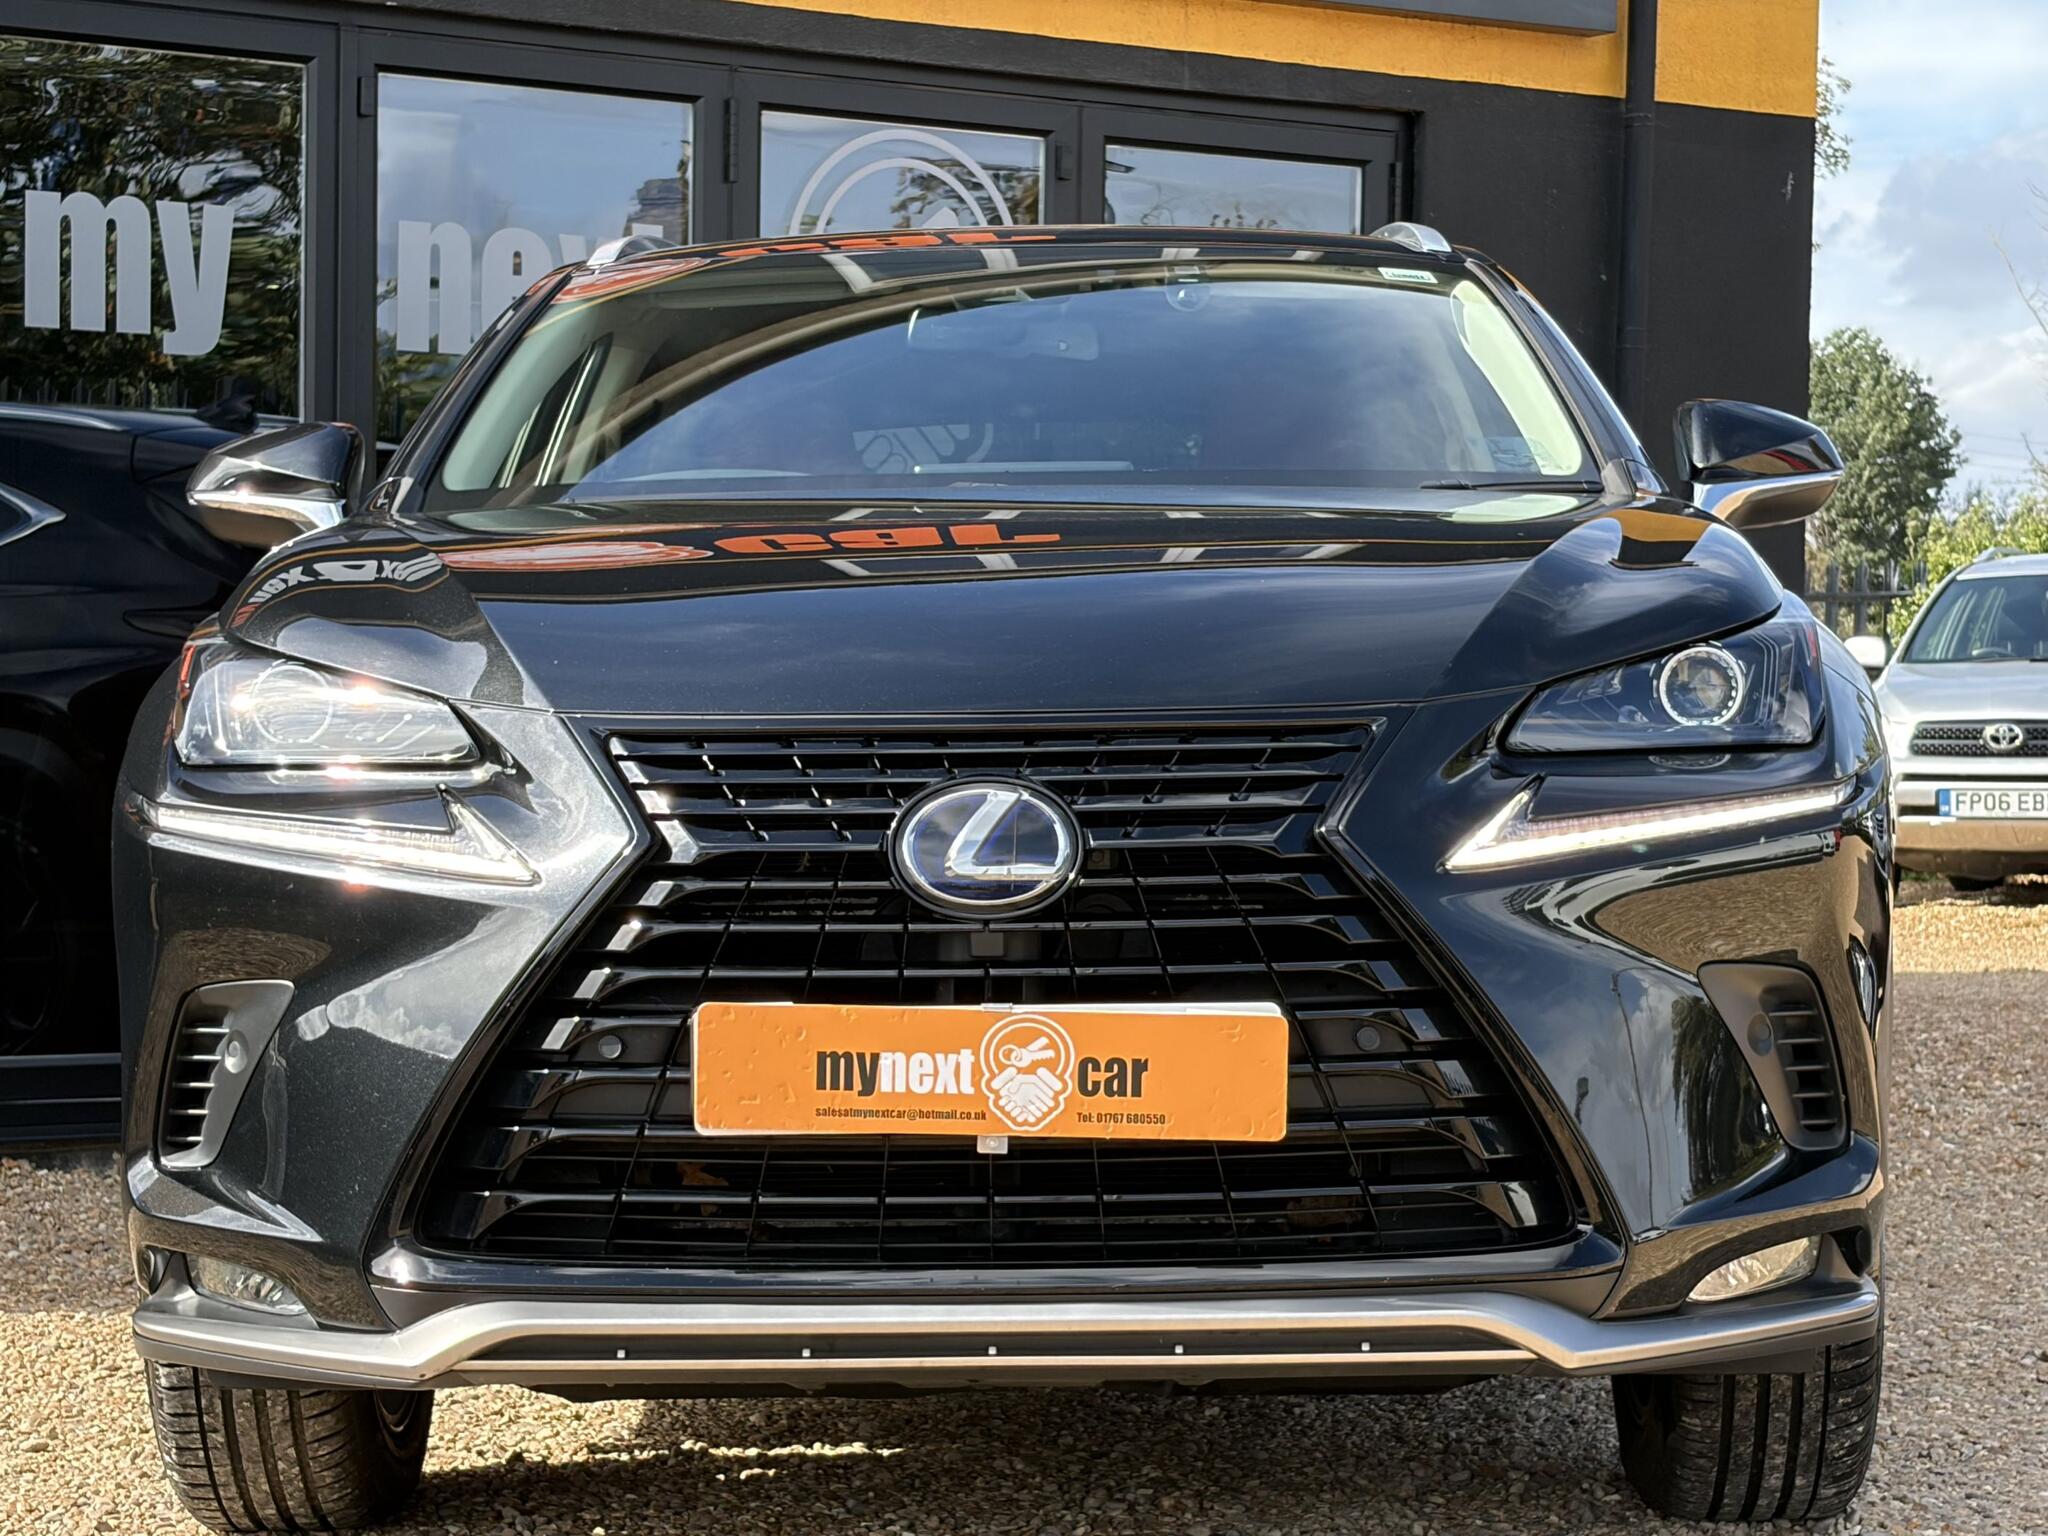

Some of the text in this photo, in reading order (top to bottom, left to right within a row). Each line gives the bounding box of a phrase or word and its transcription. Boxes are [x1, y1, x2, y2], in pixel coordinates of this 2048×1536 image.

[25, 190, 234, 355] my
[1956, 792, 2010, 811] FP06
[2018, 792, 2048, 811] EB
[816, 1049, 1149, 1097] mynext car
[815, 1106, 987, 1121] salesatmynextcar@hotmail.co.uk
[1096, 1112, 1124, 1124] 01767
[1126, 1113, 1166, 1125] 680550
